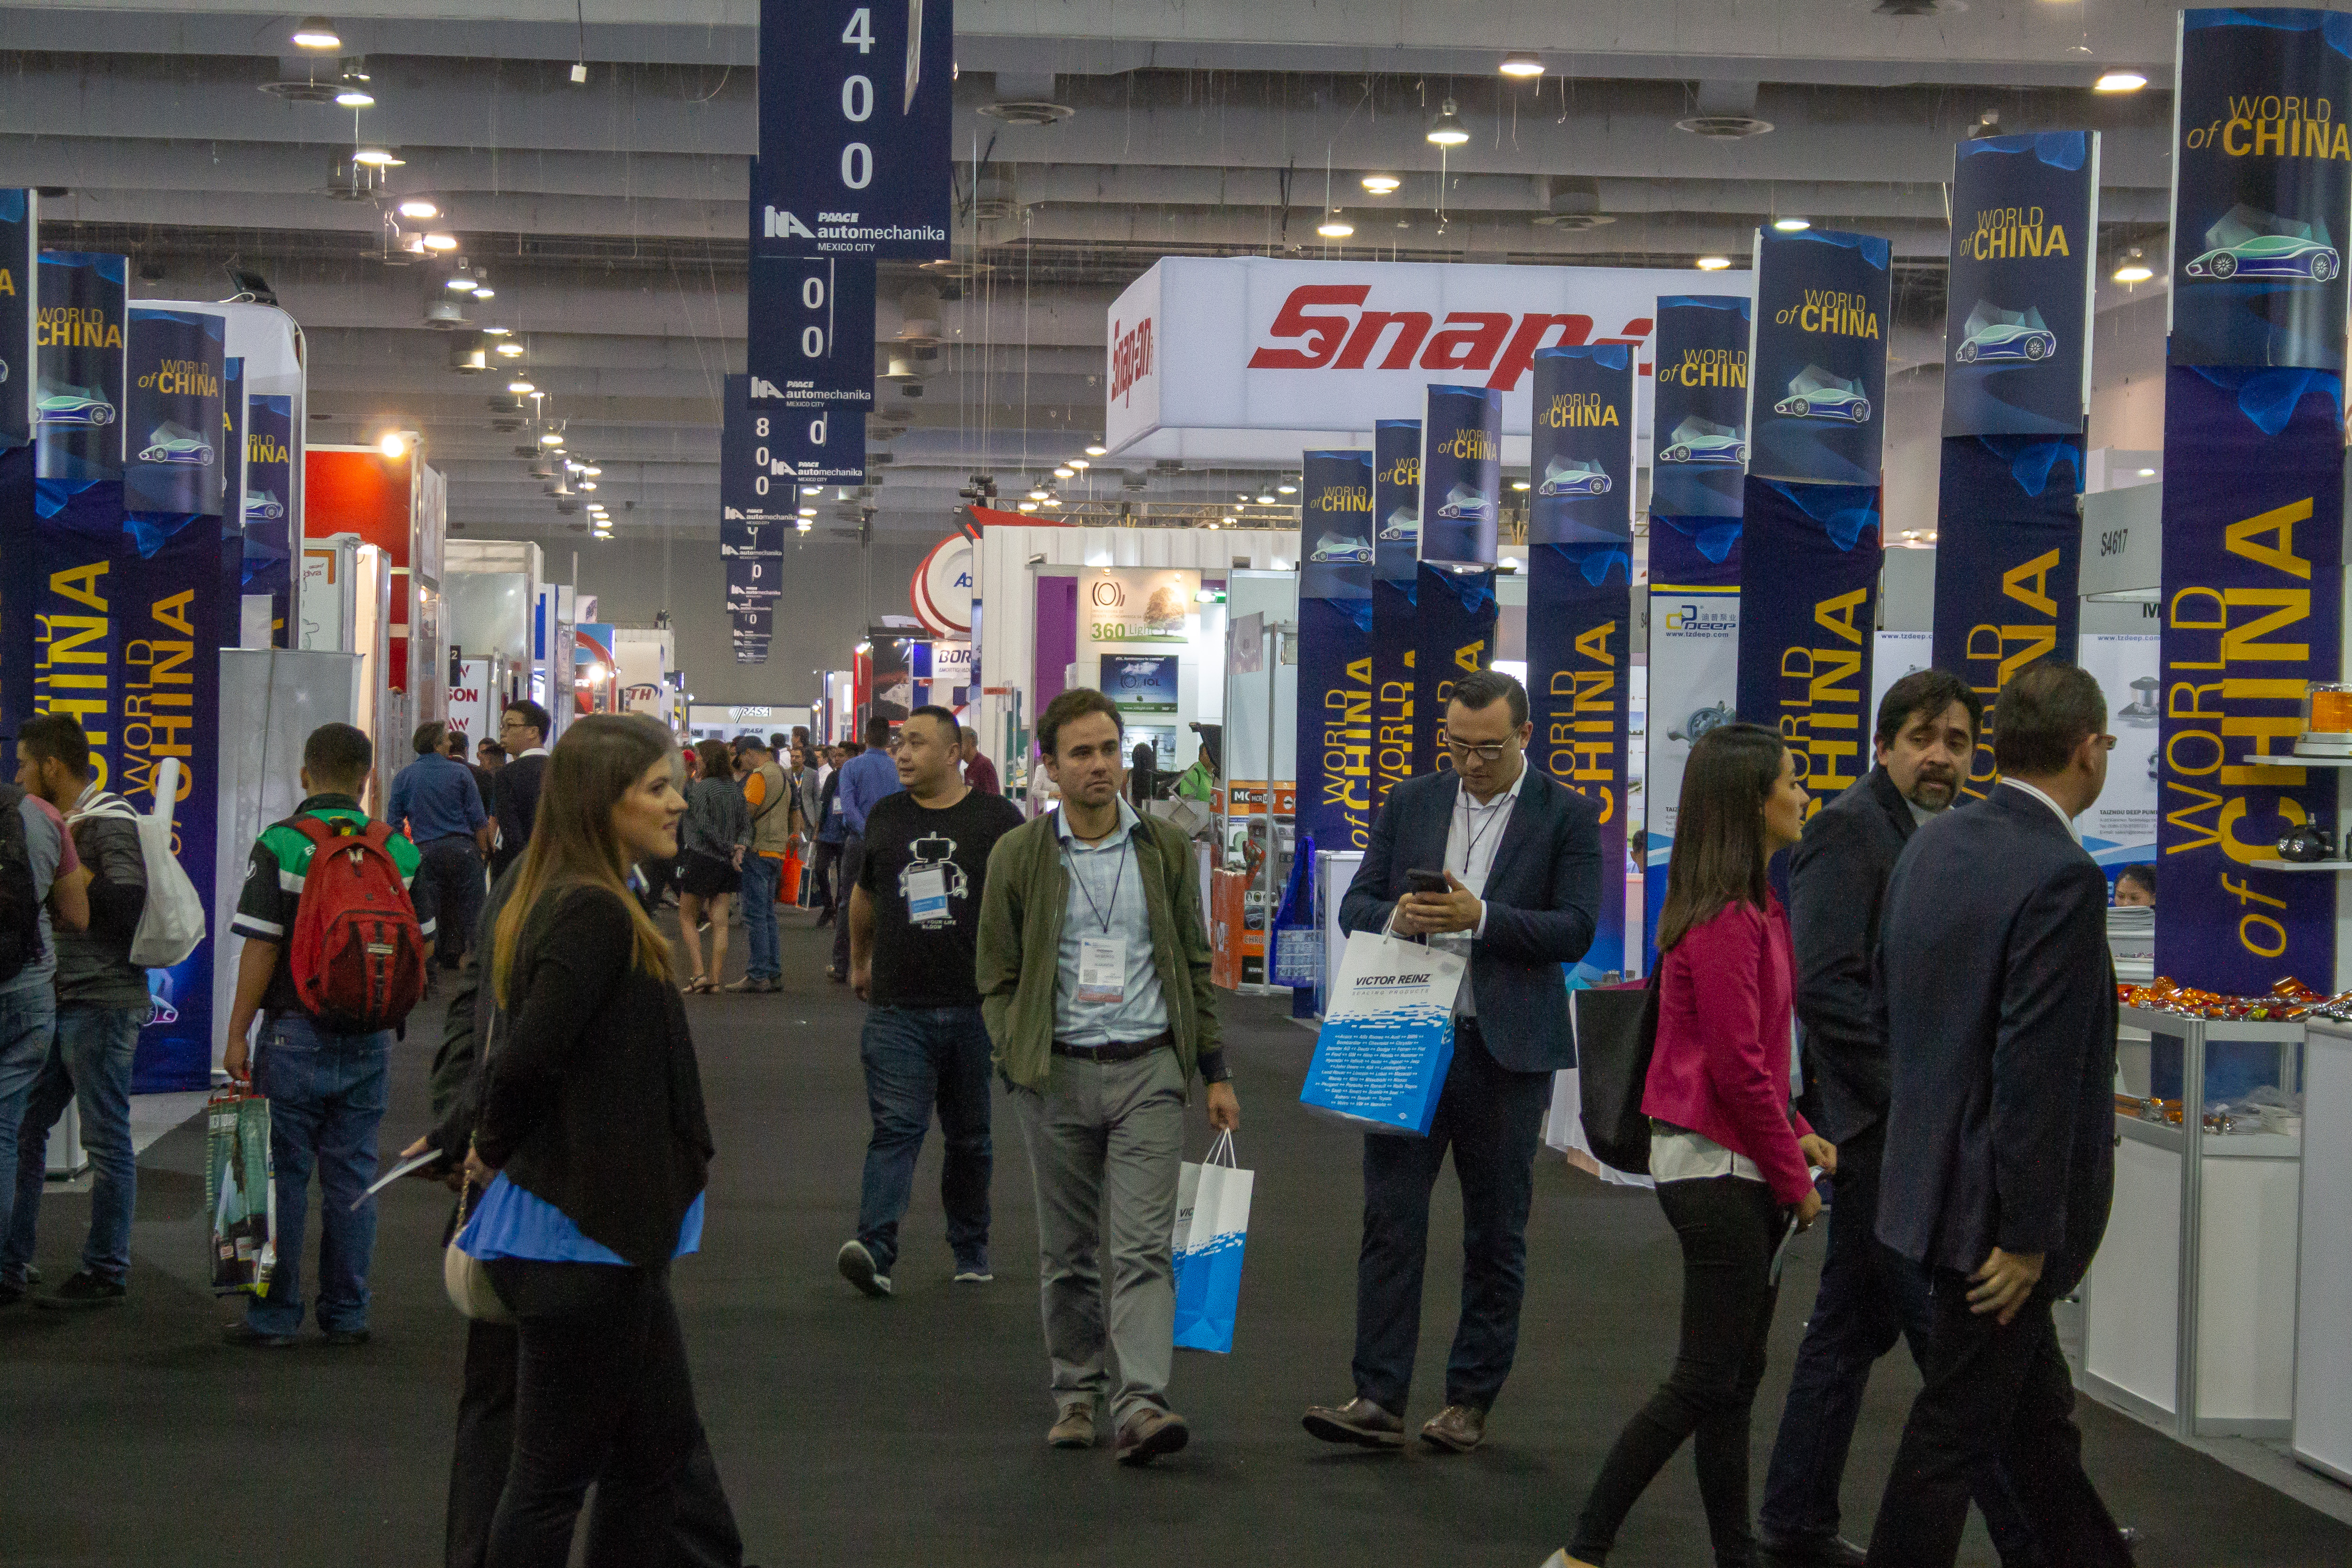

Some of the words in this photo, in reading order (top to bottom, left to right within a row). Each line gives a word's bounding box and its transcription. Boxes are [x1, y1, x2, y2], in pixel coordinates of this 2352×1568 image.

[2230, 96, 2331, 123] WORLD
[2187, 120, 2221, 149] of
[2223, 119, 2352, 161] CHINA
[818, 213, 859, 223] PAACE
[1978, 207, 2043, 229] WORLD
[818, 225, 945, 241] automechanika
[1960, 231, 1974, 256] of
[1974, 224, 2070, 261] CHINA
[818, 243, 853, 252] MEXICO
[855, 243, 875, 252] CITY
[1804, 289, 1866, 312] WORLD
[37, 307, 104, 325] WORLD
[1776, 304, 1799, 324] of
[1801, 304, 1878, 339] CHINA
[37, 321, 122, 349] CHINA
[161, 359, 209, 375] WORLD
[1111, 317, 1152, 409] Snap-on
[1684, 349, 1747, 366] WORLD
[138, 372, 158, 388] of
[159, 372, 218, 397] CHINA
[1660, 364, 1680, 382] of
[1681, 362, 1747, 388] CHIN
[786, 390, 871, 400] automechanika
[1552, 393, 1600, 408] WORLD
[1540, 407, 1551, 425] of
[1550, 405, 1619, 428] CHINA
[248, 434, 275, 447] RLD
[1456, 428, 1493, 443] WORLD
[1438, 441, 1453, 455] of
[1454, 439, 1498, 461] CHINA
[798, 468, 863, 477] automechanika
[1310, 498, 1321, 509] of
[1322, 494, 1373, 512] CHINA
[1324, 486, 1366, 497] WORLD
[2101, 528, 2128, 557] S4617
[1092, 622, 1125, 639] 360
[1129, 623, 1154, 636] Light
[2218, 496, 2314, 864] CHINA
[149, 589, 194, 802] CHINA
[123, 639, 154, 796] WORLD
[742, 707, 771, 716] RASA
[1780, 646, 1814, 782] ORLD
[2166, 586, 2227, 854] WORLD
[1343, 657, 1373, 811] CHINA
[1549, 671, 1577, 795] ORLD
[1323, 689, 1348, 805] WORLD
[1351, 814, 1370, 850] of
[2221, 872, 2288, 958] of
[1356, 976, 1396, 986] VICTOR
[1398, 973, 1430, 984] REINZ
[1180, 1207, 1194, 1217] VIC
